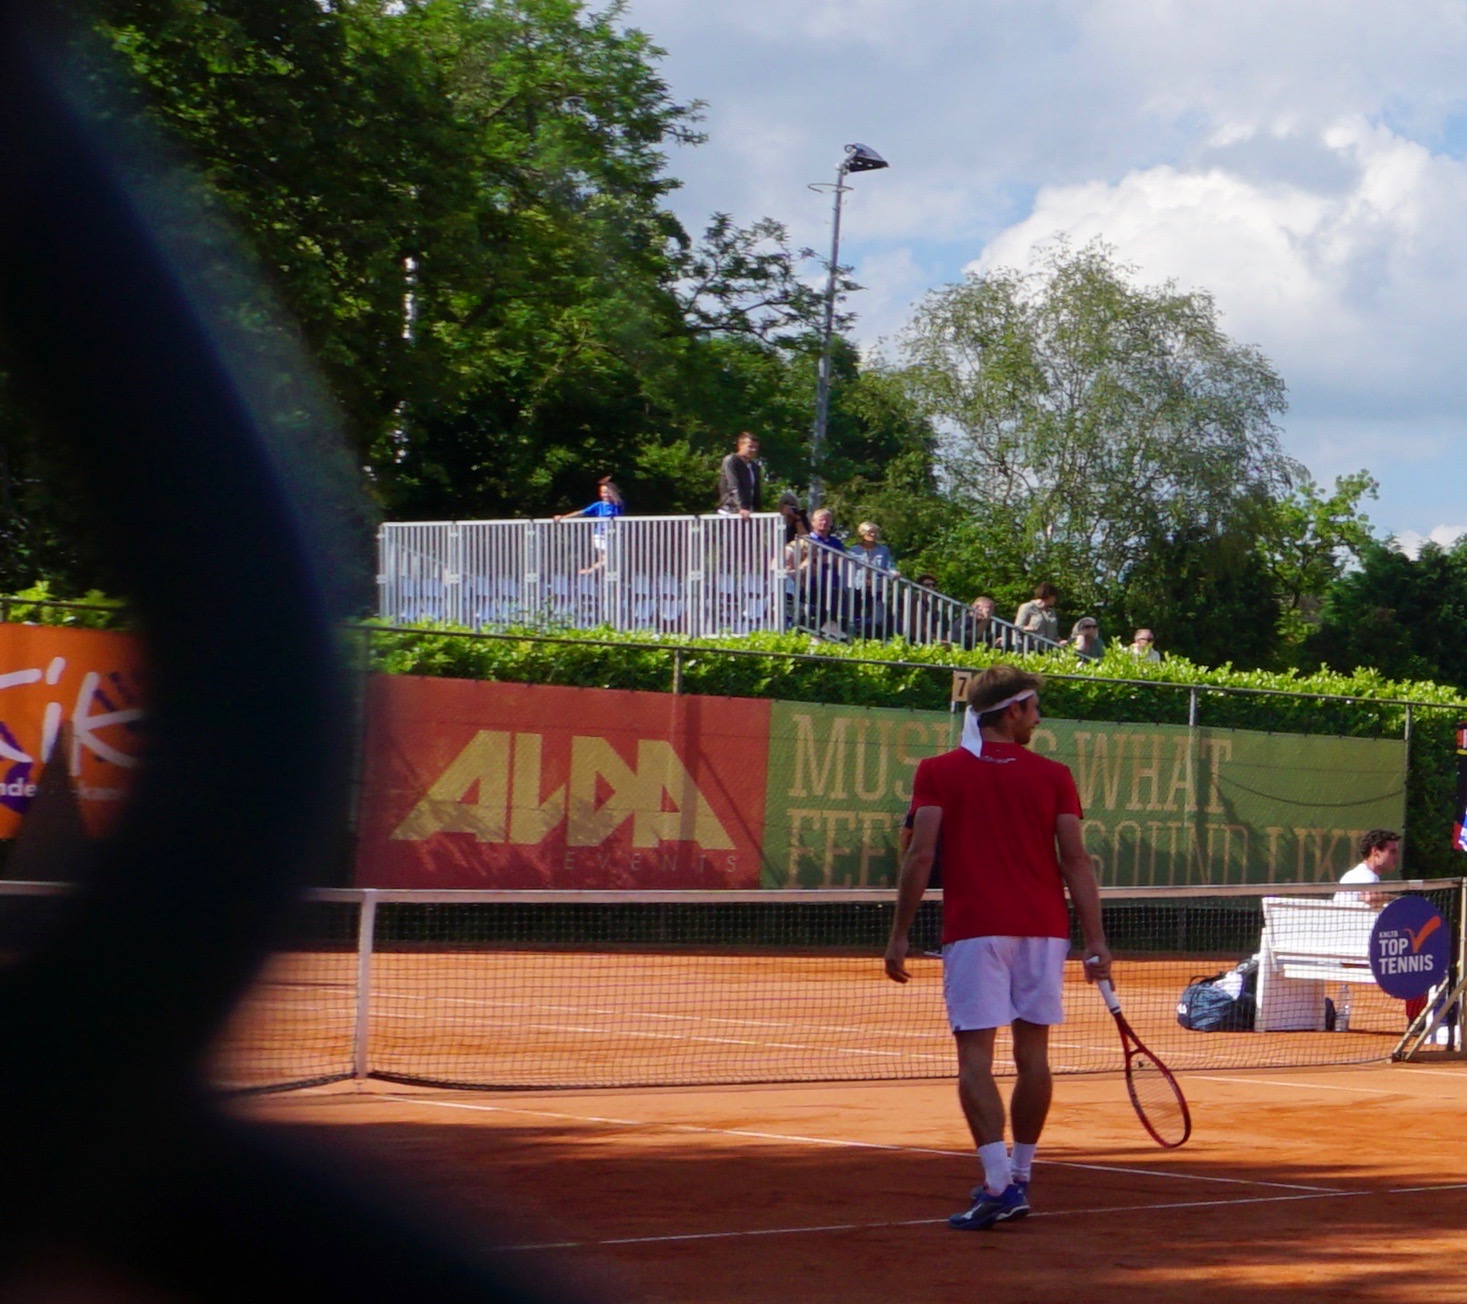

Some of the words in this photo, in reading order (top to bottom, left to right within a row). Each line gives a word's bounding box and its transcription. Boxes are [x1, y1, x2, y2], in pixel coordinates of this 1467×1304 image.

[957, 676, 968, 695] 7
[1074, 731, 1233, 814] WHAT
[390, 730, 736, 850] ALDA
[564, 851, 737, 873] EVENTS
[1379, 938, 1408, 956] TOP
[1379, 954, 1434, 975] TENNIS
